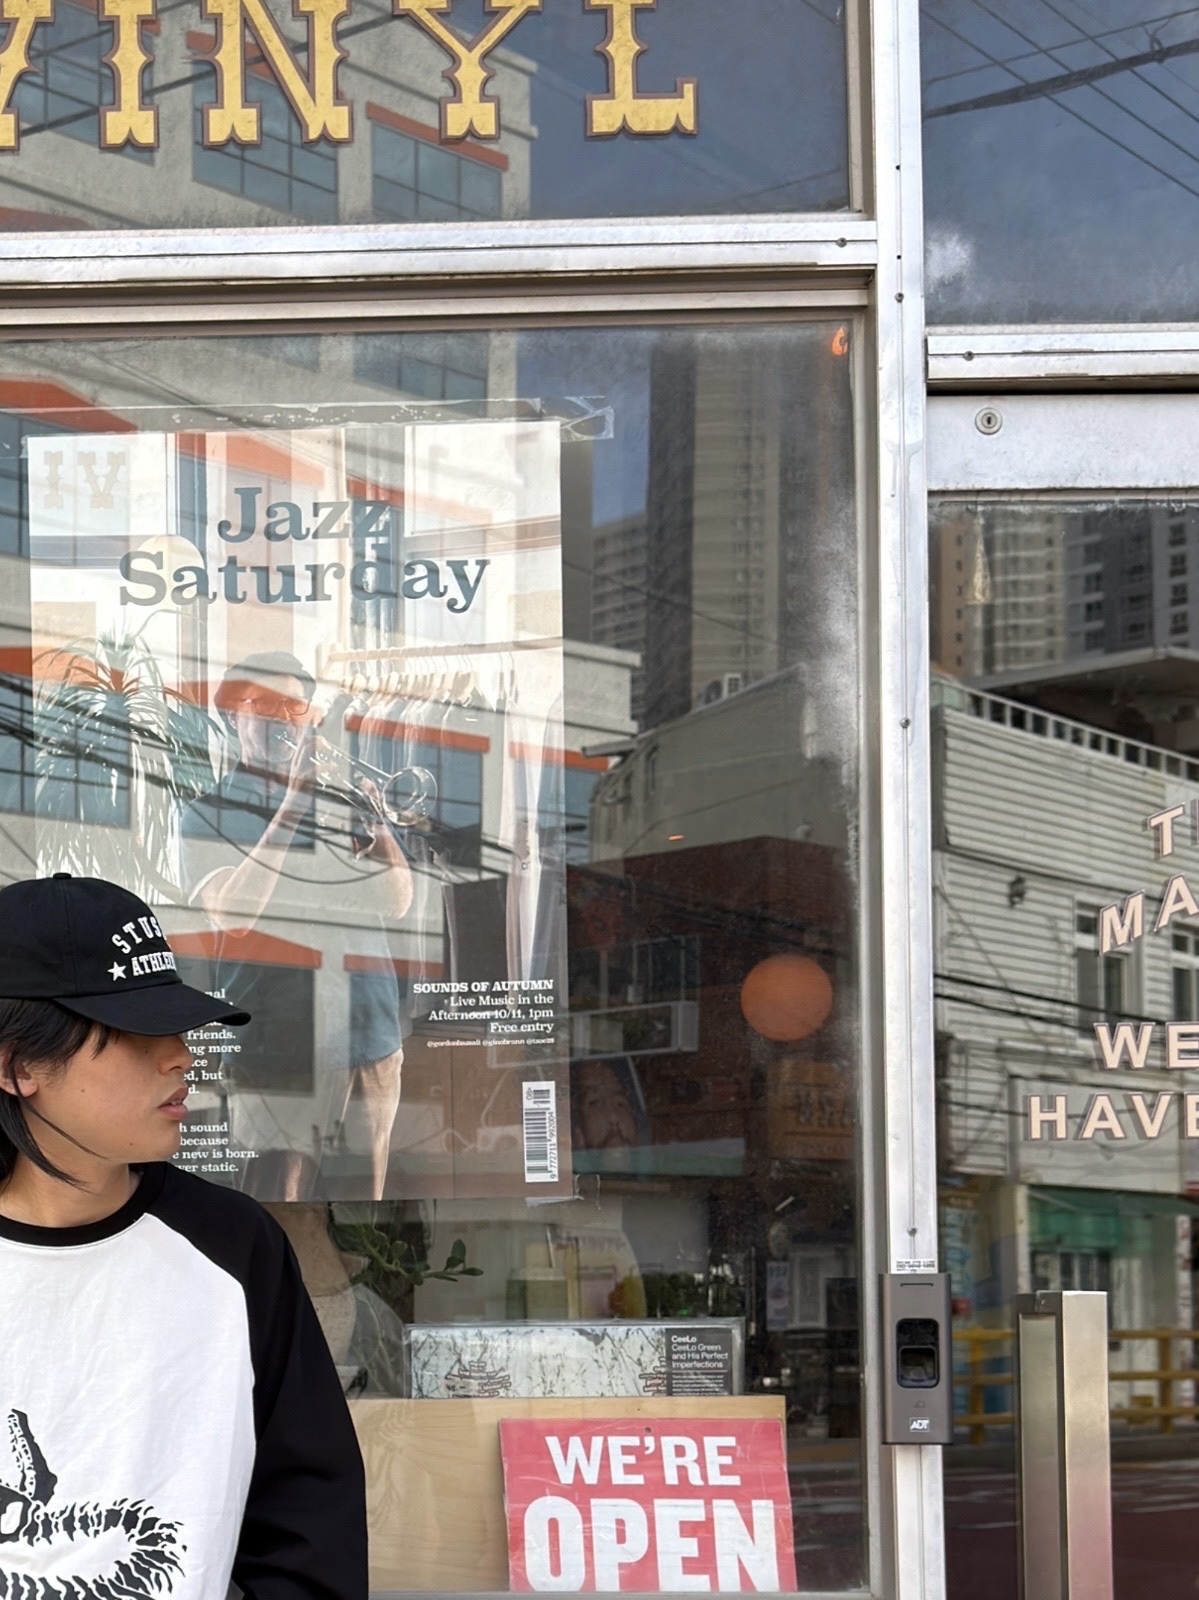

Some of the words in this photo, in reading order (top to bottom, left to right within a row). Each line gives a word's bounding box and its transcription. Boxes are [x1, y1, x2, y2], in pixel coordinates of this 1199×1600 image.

[217, 486, 392, 545] Jazz
[118, 545, 492, 614] Saturday
[111, 916, 163, 954] STUS
[413, 982, 468, 994] SOUNDS
[471, 981, 489, 992] OF
[492, 979, 554, 992] AUTUMN
[450, 996, 476, 1007] Live
[479, 995, 515, 1007] Music
[518, 994, 531, 1005] in
[534, 993, 554, 1004] the
[428, 1010, 491, 1021] Afternoon
[494, 1009, 526, 1019] 10/11,
[529, 1009, 554, 1020] 1pm
[490, 1022, 518, 1033] Free
[520, 1023, 554, 1034] entry
[187, 1029, 237, 1040] friends.
[185, 1044, 206, 1056] ng
[208, 1044, 242, 1053] more
[1093, 1022, 1199, 1070] WE
[191, 1059, 208, 1067] ce
[201, 1070, 223, 1080] but
[190, 1121, 228, 1132] sound
[548, 1111, 556, 1138] 992004
[180, 1136, 229, 1146] because
[182, 1151, 209, 1159] new
[212, 1148, 223, 1159] is
[225, 1148, 259, 1158] born.
[549, 1142, 557, 1169] 772711
[201, 1162, 239, 1172] static.
[671, 1335, 697, 1343] CeeLo
[671, 1343, 697, 1352] CeeLo
[697, 1343, 722, 1351] Green
[672, 1352, 686, 1360] and
[687, 1352, 700, 1360] His
[701, 1352, 728, 1360] Perfect
[672, 1361, 724, 1369] Imperfections
[910, 1419, 930, 1430] ADT
[545, 1435, 742, 1486] WE'RE
[523, 1495, 781, 1592] OPEN
